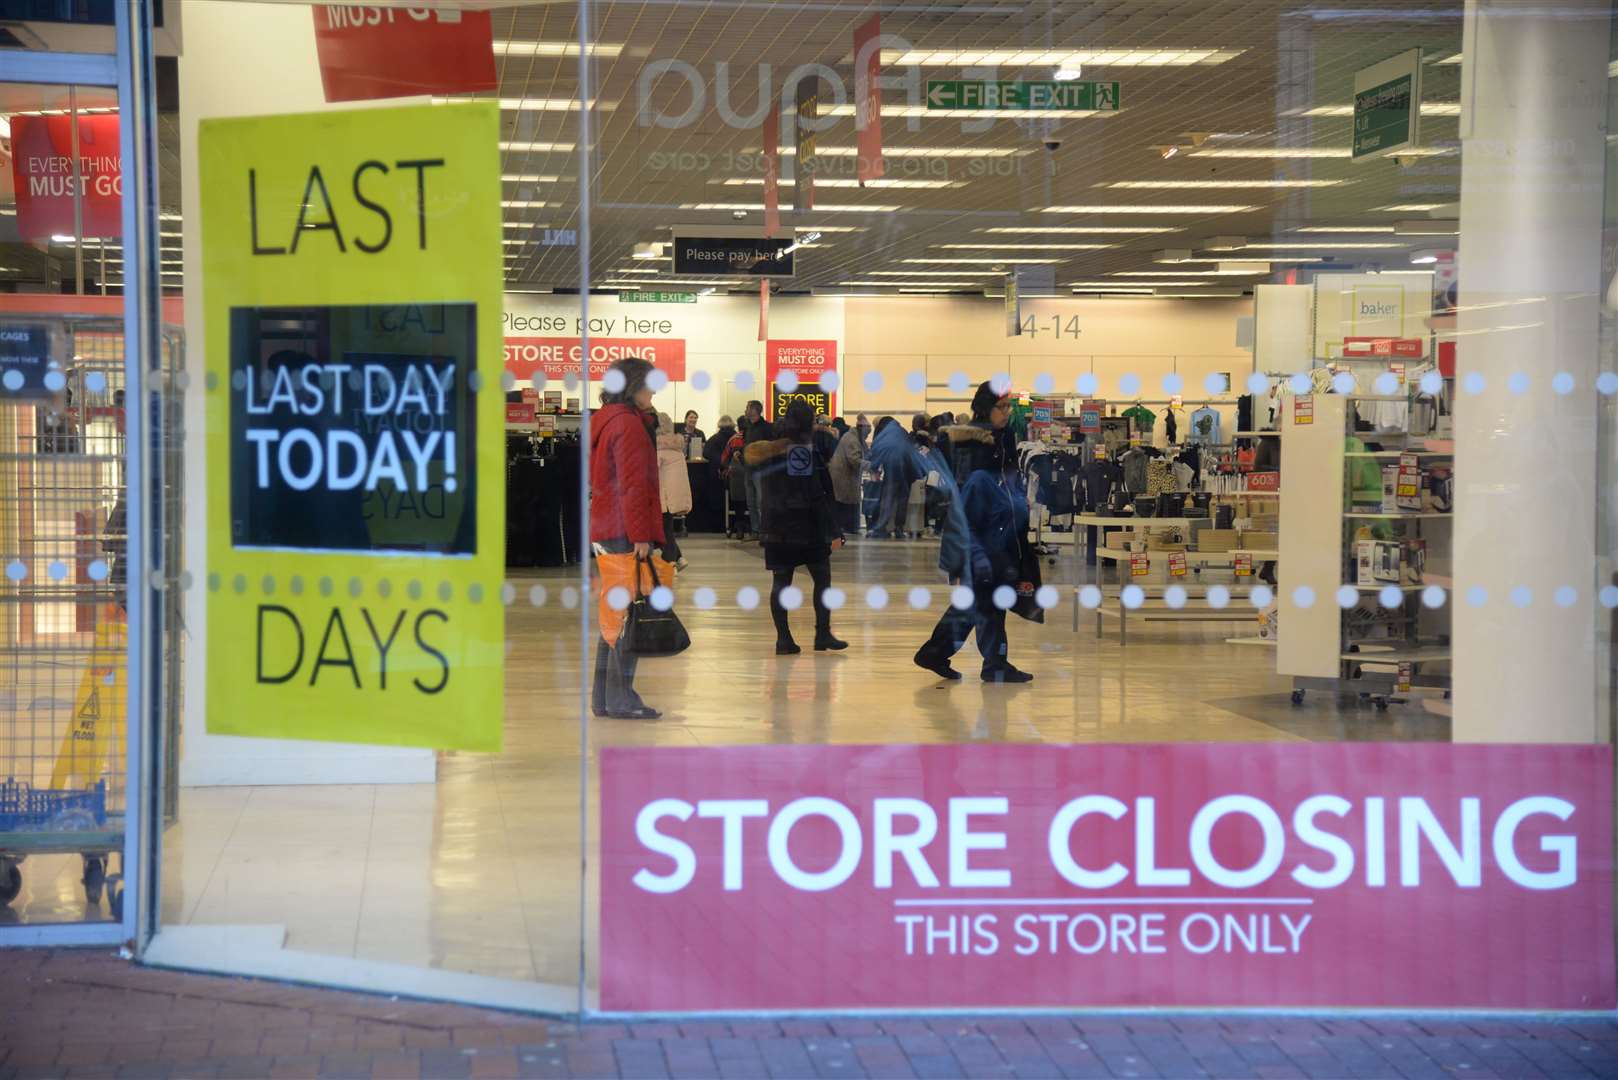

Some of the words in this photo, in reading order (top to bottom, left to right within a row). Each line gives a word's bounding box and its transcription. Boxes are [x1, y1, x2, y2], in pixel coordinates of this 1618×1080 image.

[963, 84, 1017, 107] FIRE
[1029, 84, 1085, 107] EXIT
[30, 174, 90, 197] MUST
[248, 159, 445, 256] LAST
[686, 248, 725, 261] Please
[729, 251, 752, 263] pay
[633, 292, 657, 302] FIRE
[660, 292, 684, 302] EXIT
[1360, 302, 1397, 315] baker
[576, 315, 616, 336] pay
[624, 315, 673, 334] here
[778, 347, 825, 356] EVERYTHING
[778, 355, 806, 365] MUST
[808, 355, 825, 365] GO
[544, 364, 562, 374] THIS
[247, 364, 351, 416] LAST
[364, 364, 456, 415] DAY
[246, 428, 457, 493] TODAY!
[256, 604, 450, 695] DAYS
[632, 795, 1013, 895] STORE
[1047, 794, 1578, 890] CLOSING
[895, 914, 999, 955] THIS
[1014, 913, 1167, 955] STORE
[1180, 913, 1312, 954] ONLY
